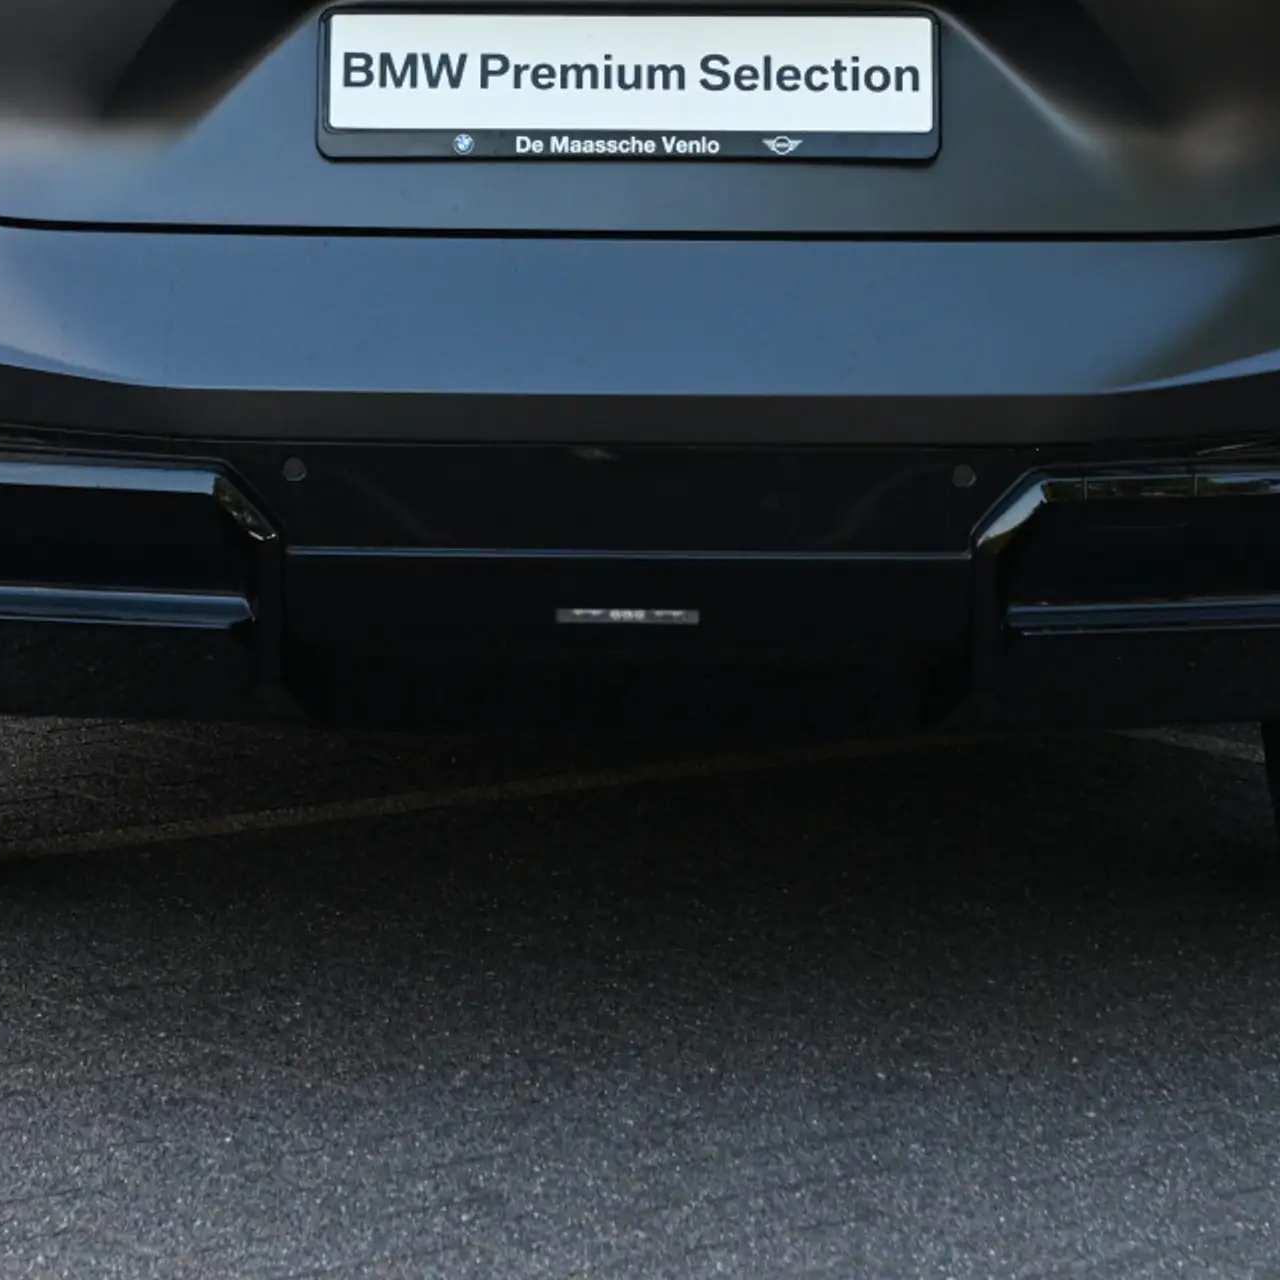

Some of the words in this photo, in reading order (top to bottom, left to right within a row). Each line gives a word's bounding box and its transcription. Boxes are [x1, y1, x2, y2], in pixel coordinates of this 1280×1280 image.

[343, 51, 468, 89] BMW
[480, 53, 686, 90] Premium
[699, 54, 920, 93] Selection
[515, 135, 544, 154] De
[549, 135, 657, 154] Maassche
[660, 135, 720, 154] Venlo
